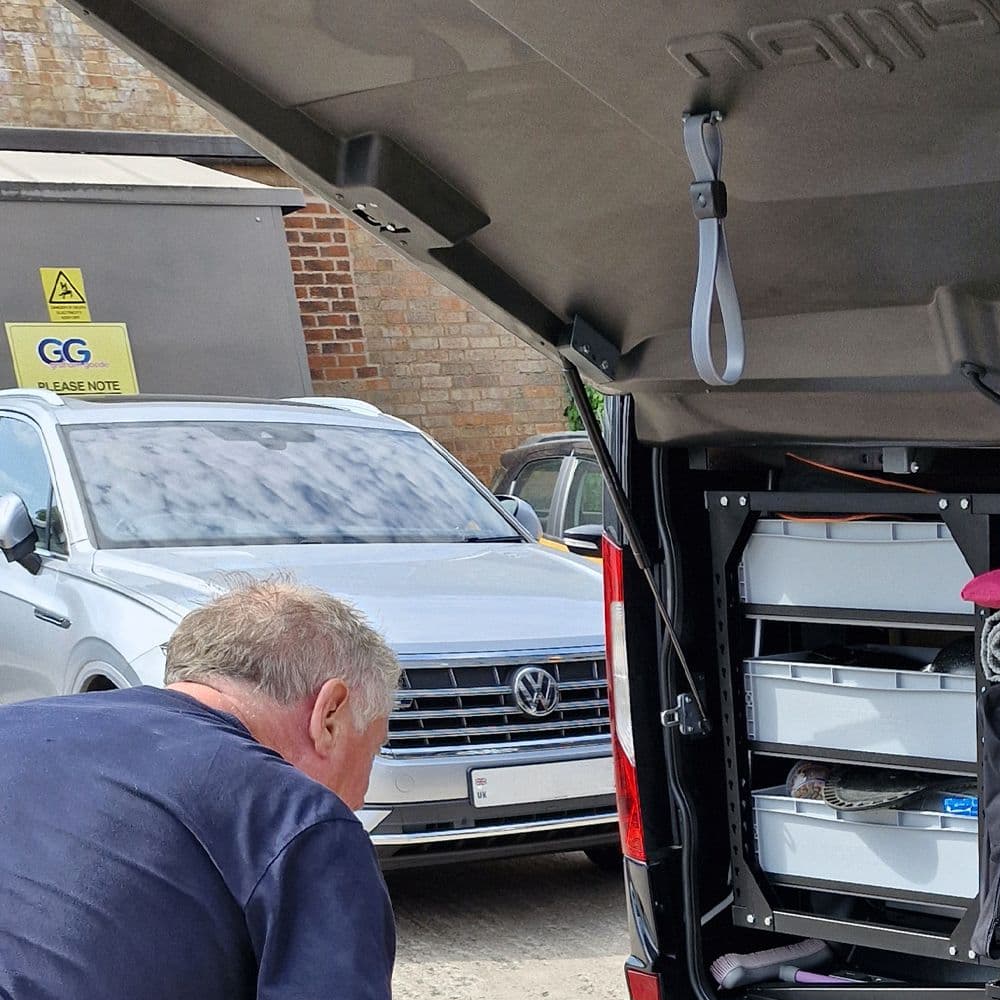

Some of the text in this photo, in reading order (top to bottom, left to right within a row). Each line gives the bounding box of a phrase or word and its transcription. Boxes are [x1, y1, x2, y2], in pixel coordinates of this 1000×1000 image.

[37, 338, 92, 365] GG
[38, 381, 121, 392] PLEASE NOTE
[477, 791, 487, 799] UK
